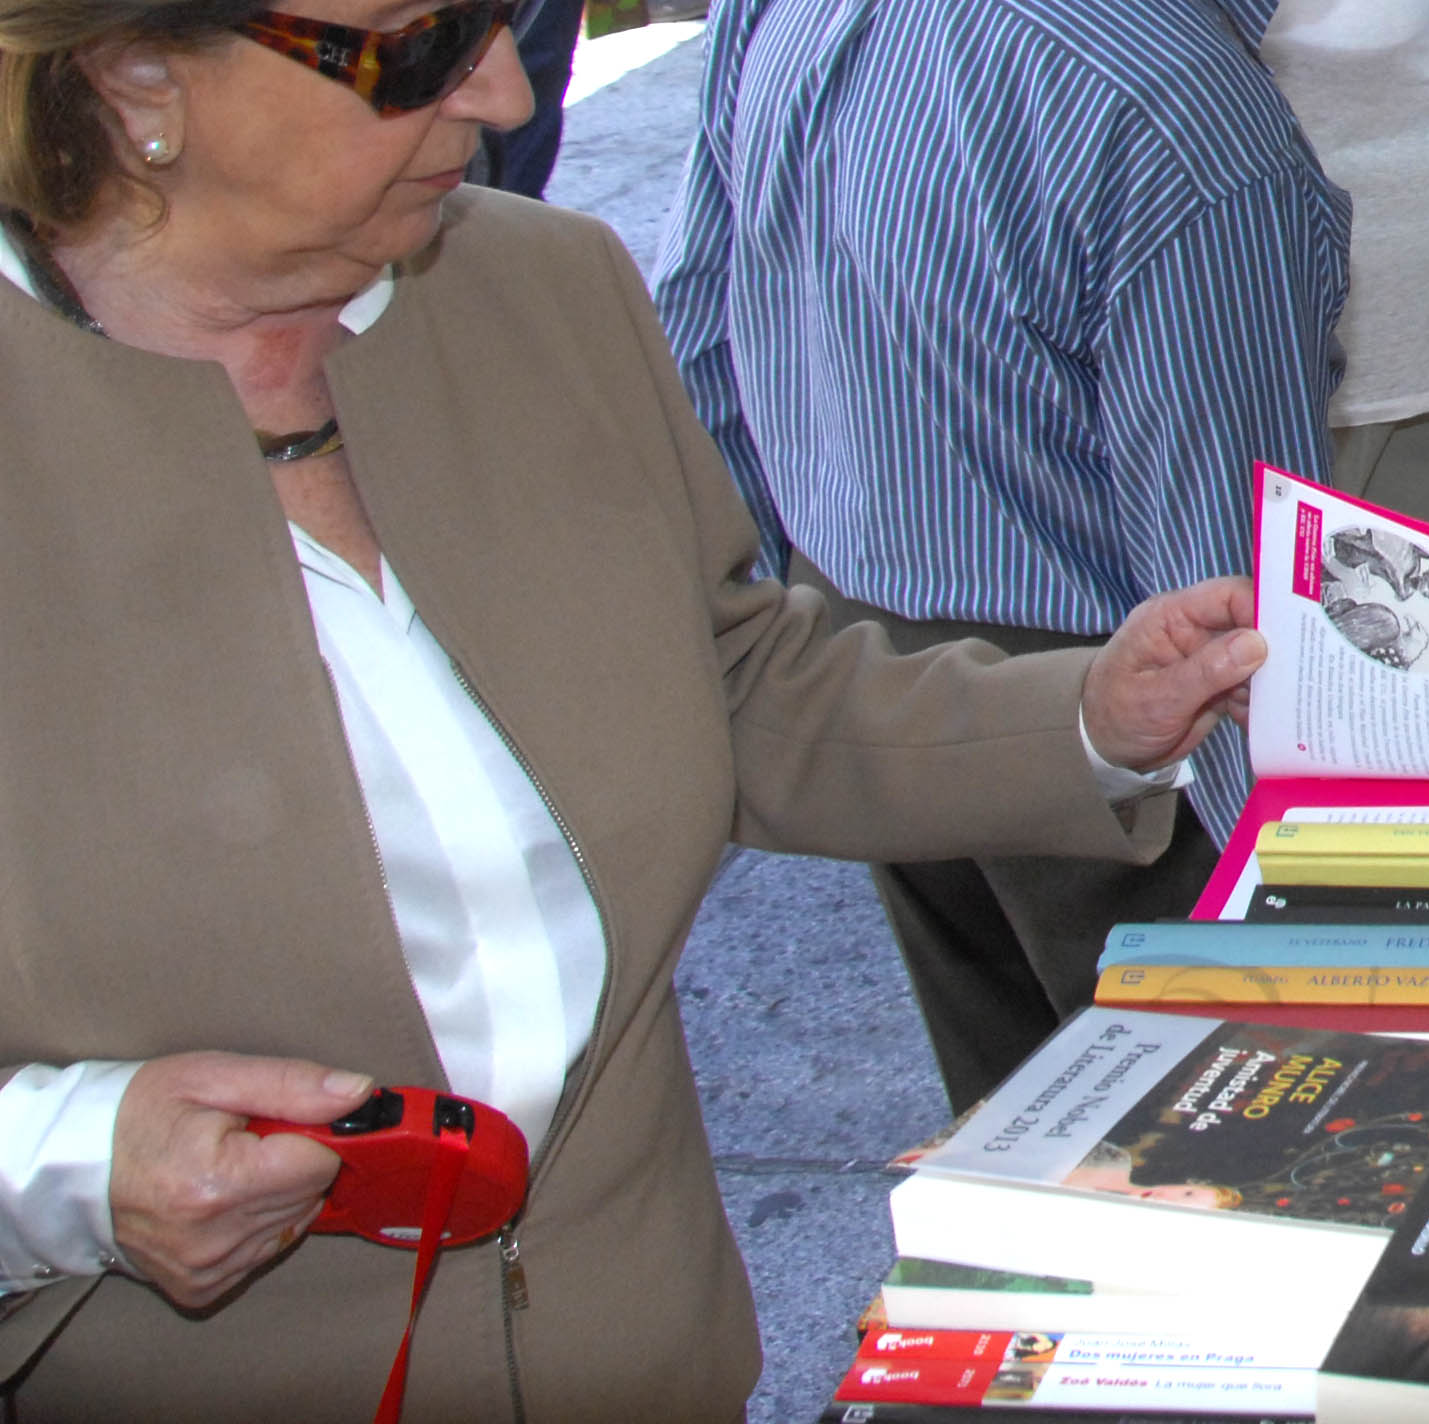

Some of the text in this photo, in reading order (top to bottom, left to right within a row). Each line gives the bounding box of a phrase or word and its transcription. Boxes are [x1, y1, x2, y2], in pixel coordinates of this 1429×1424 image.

[1395, 901, 1413, 912] LA
[1306, 974, 1390, 987] ALBERTO
[984, 1024, 1132, 1153] de Literatura 2013
[1044, 1041, 1161, 1140] Premio Nobel
[1172, 1046, 1247, 1116] juventud
[1204, 1049, 1276, 1114] Amistad
[1242, 1053, 1312, 1121] MUNRO
[1303, 1056, 1342, 1105] ALICE
[1188, 1110, 1222, 1132] de
[1068, 1349, 1102, 1361] Dos
[1106, 1350, 1178, 1365] mujeres
[1204, 1352, 1256, 1367] Praga
[1095, 1376, 1148, 1388] Valdés
